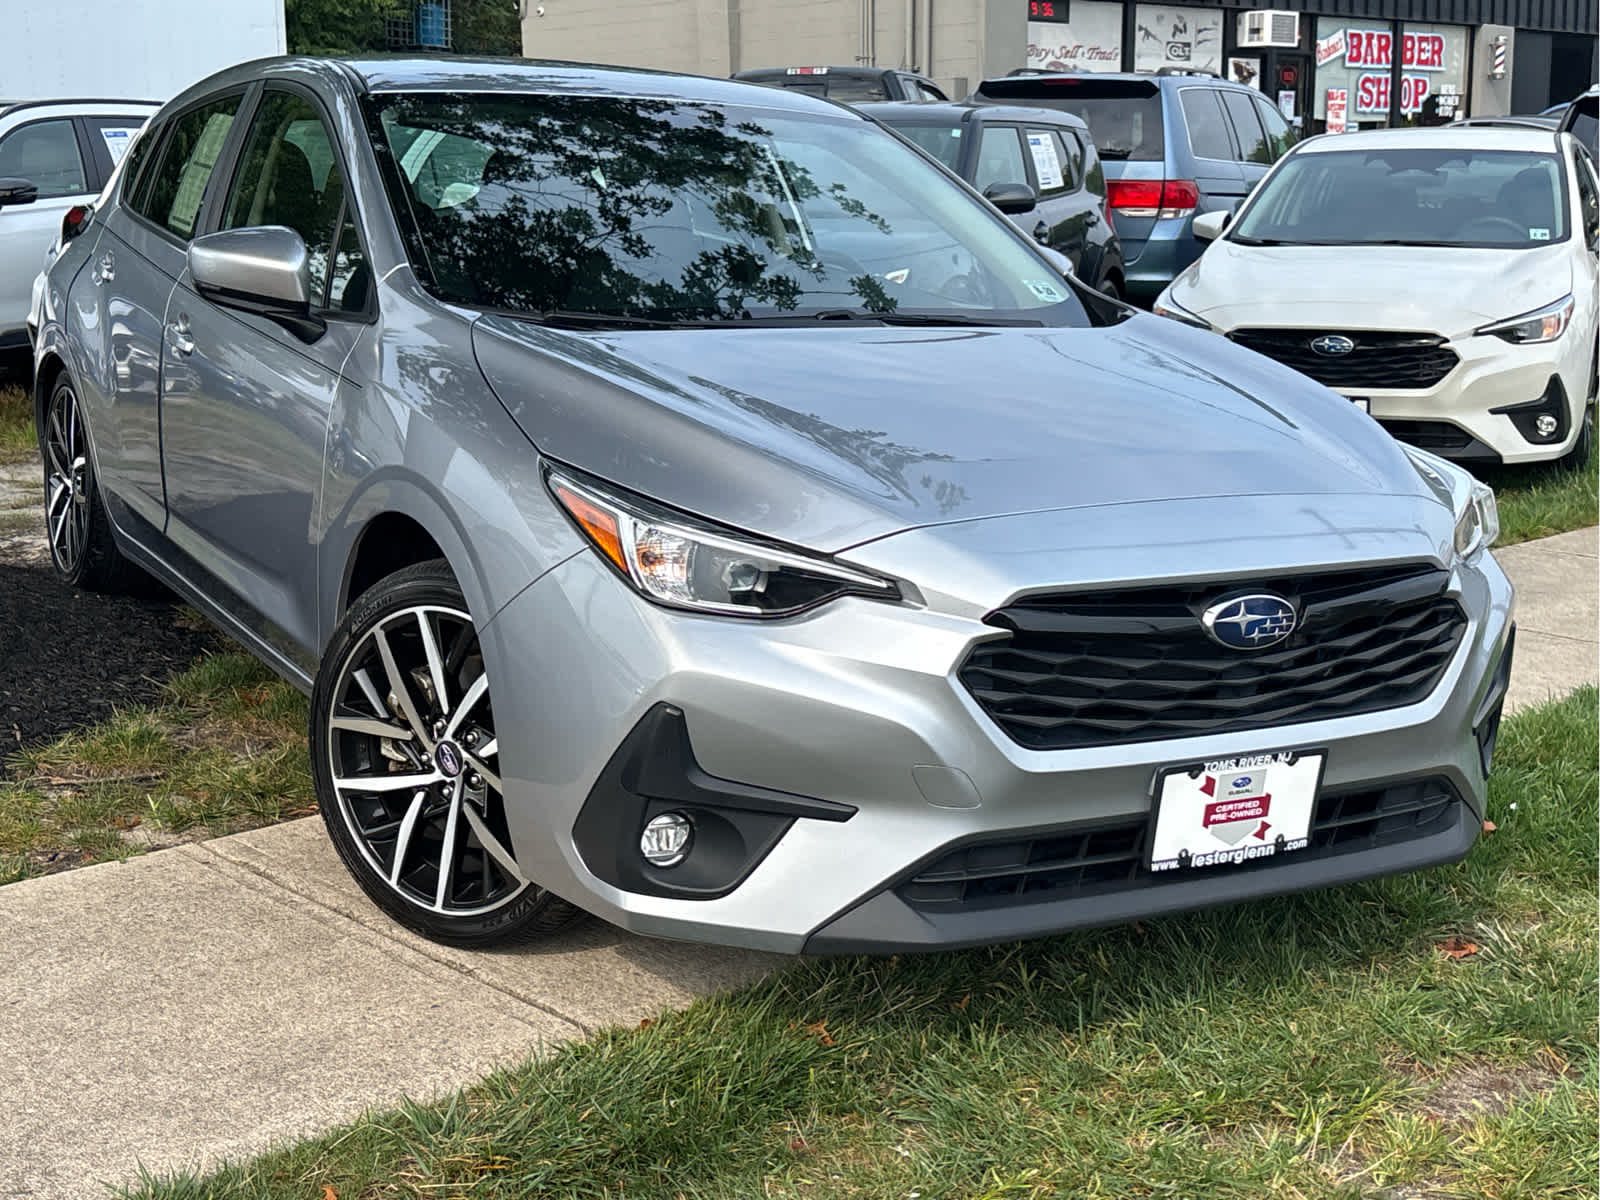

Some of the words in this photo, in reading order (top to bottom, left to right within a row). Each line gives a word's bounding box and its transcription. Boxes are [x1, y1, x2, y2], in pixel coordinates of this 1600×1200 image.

[1026, 44, 1051, 62] Buy
[1055, 45, 1084, 60] Sell
[1166, 42, 1191, 60] COLT
[1346, 31, 1444, 68] BARBER
[1359, 75, 1428, 110] SHOP
[1204, 759, 1236, 772] TOMS
[1277, 751, 1293, 763] NJ
[1209, 807, 1263, 822] PRE-OWNED
[1215, 800, 1260, 813] CERTIFIED
[1191, 844, 1275, 868] lesterglenn
